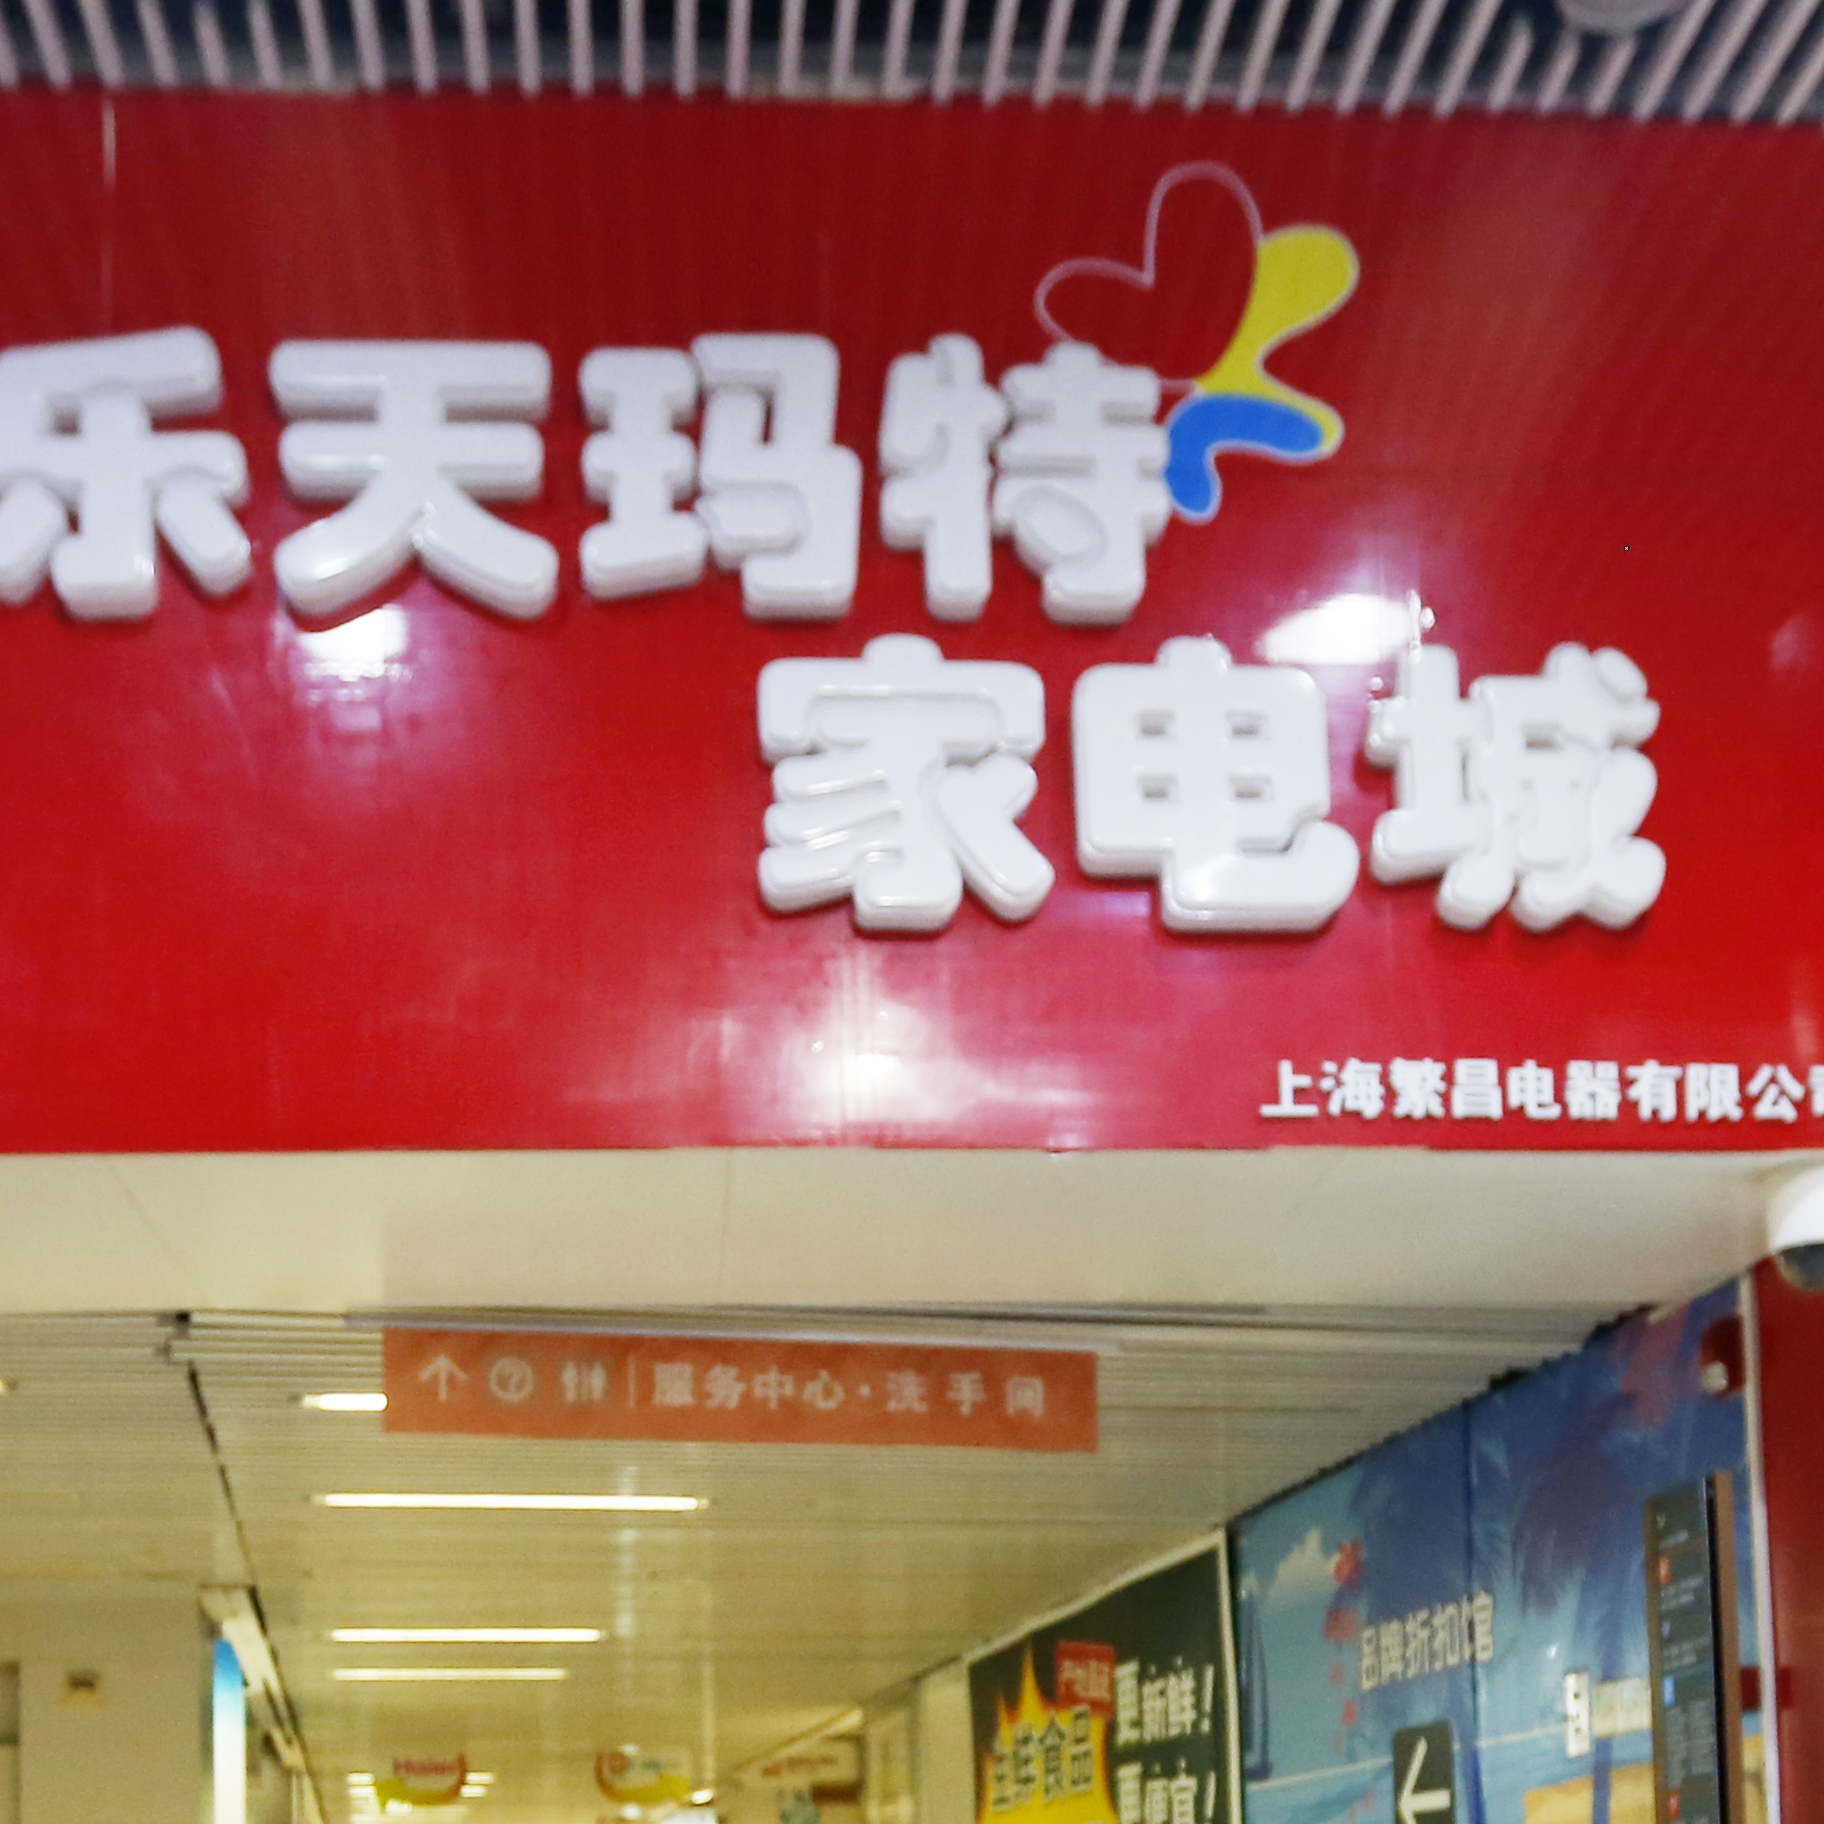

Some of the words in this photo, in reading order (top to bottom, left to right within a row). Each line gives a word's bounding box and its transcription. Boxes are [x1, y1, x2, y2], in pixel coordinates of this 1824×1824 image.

[756, 634, 1668, 937] 家电城
[1360, 1590, 1495, 1691] 品牌折扣馆
